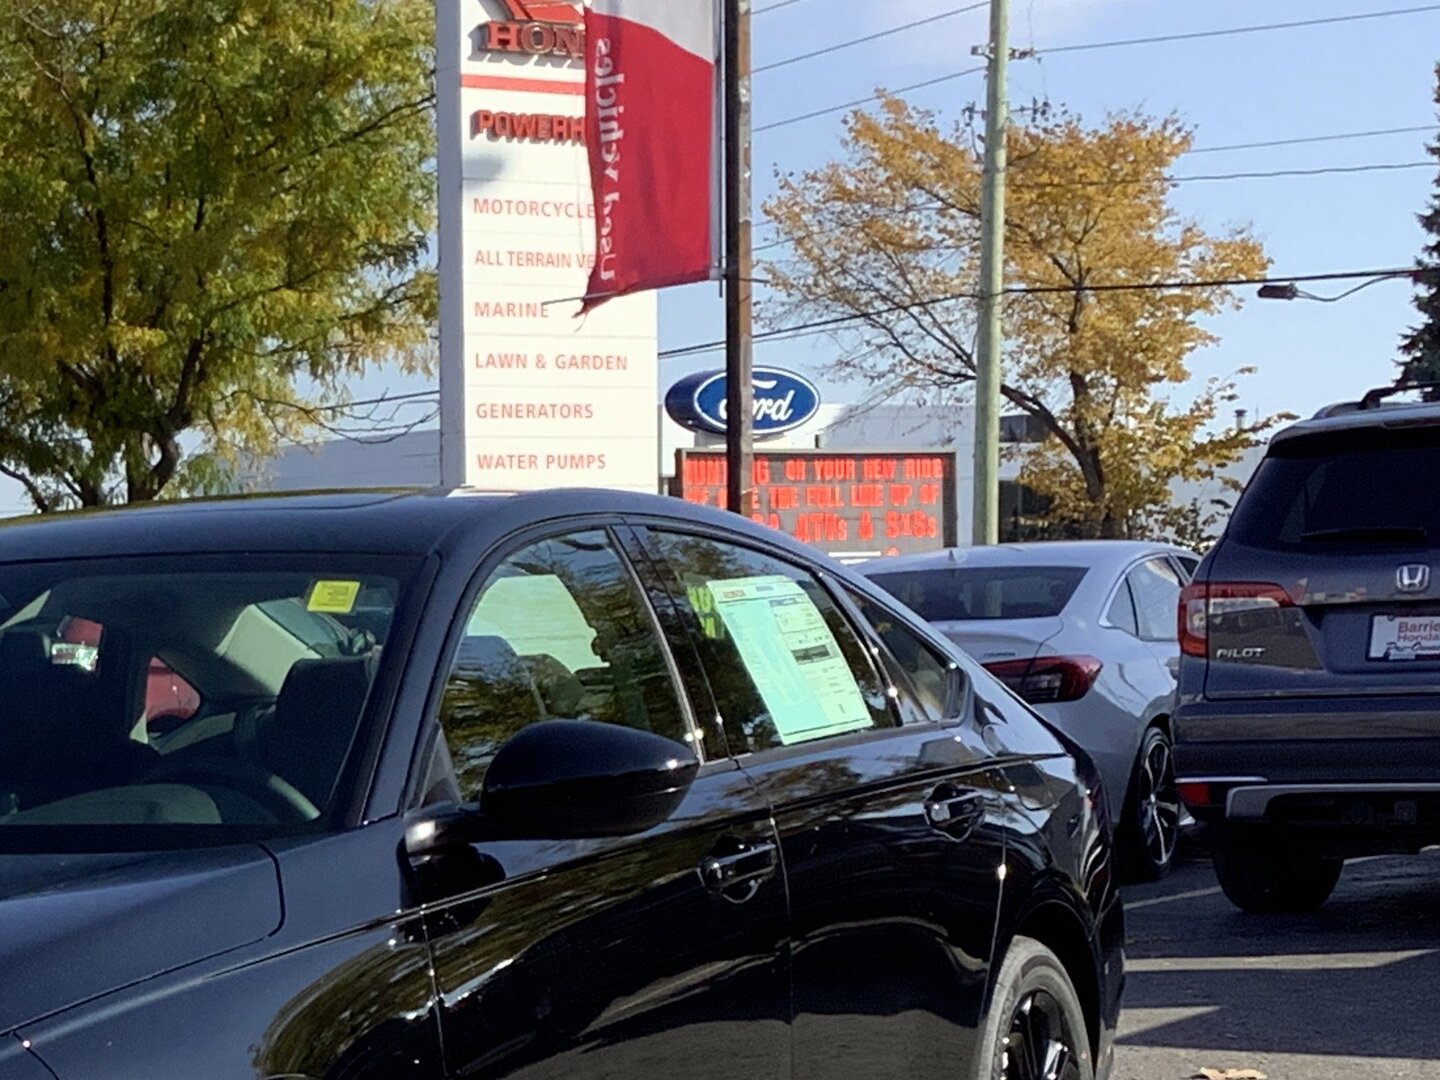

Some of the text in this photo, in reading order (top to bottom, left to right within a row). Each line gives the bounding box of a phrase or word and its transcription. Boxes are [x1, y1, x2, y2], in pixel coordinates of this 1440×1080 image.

[484, 21, 585, 58] HON
[474, 110, 586, 141] POWERH
[473, 198, 595, 218] MOTORCYCLE
[475, 250, 503, 266] ALL
[507, 251, 571, 268] TERRAIN
[474, 302, 549, 318] MARINE
[475, 353, 628, 370] LAWN & GARDEN
[476, 403, 593, 419] GENERATORS
[477, 454, 607, 469] WATER PUMPS
[814, 458, 855, 480] YOUR
[1216, 648, 1266, 658] PILOT
